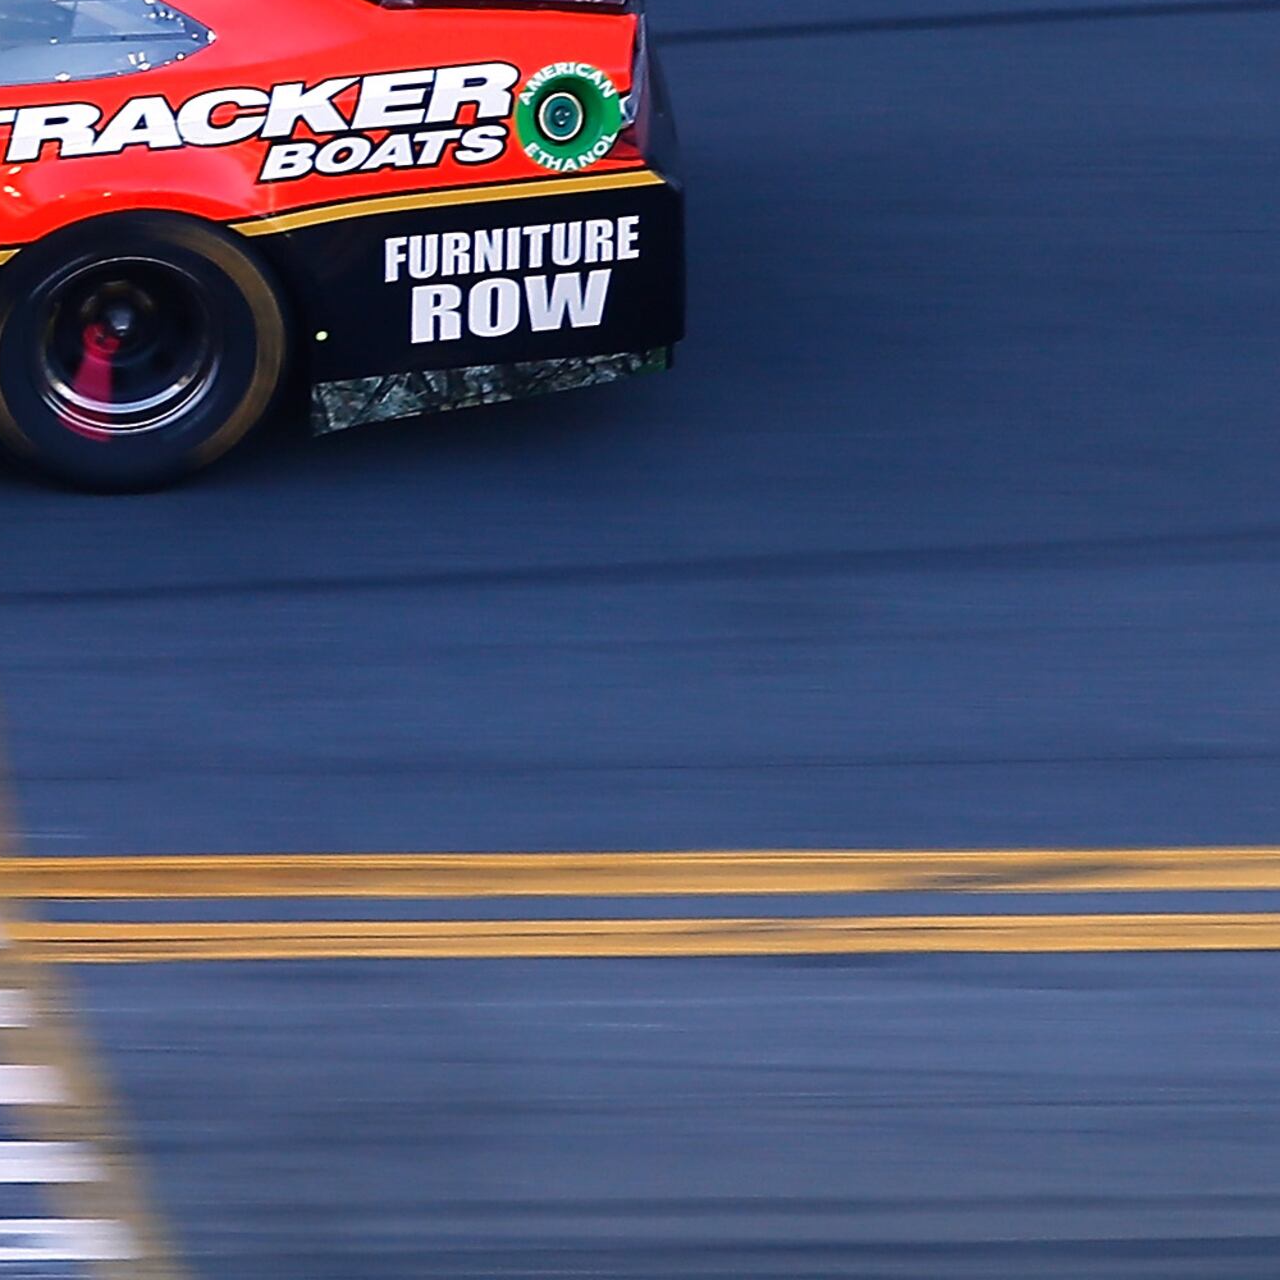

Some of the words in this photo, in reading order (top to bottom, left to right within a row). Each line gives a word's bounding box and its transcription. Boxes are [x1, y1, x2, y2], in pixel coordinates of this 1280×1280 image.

[519, 61, 617, 106] AMERICAN
[258, 124, 507, 182] BOATS
[523, 131, 618, 173] ETHANOL
[383, 214, 640, 283] FURNITURE
[410, 269, 613, 344] ROW
